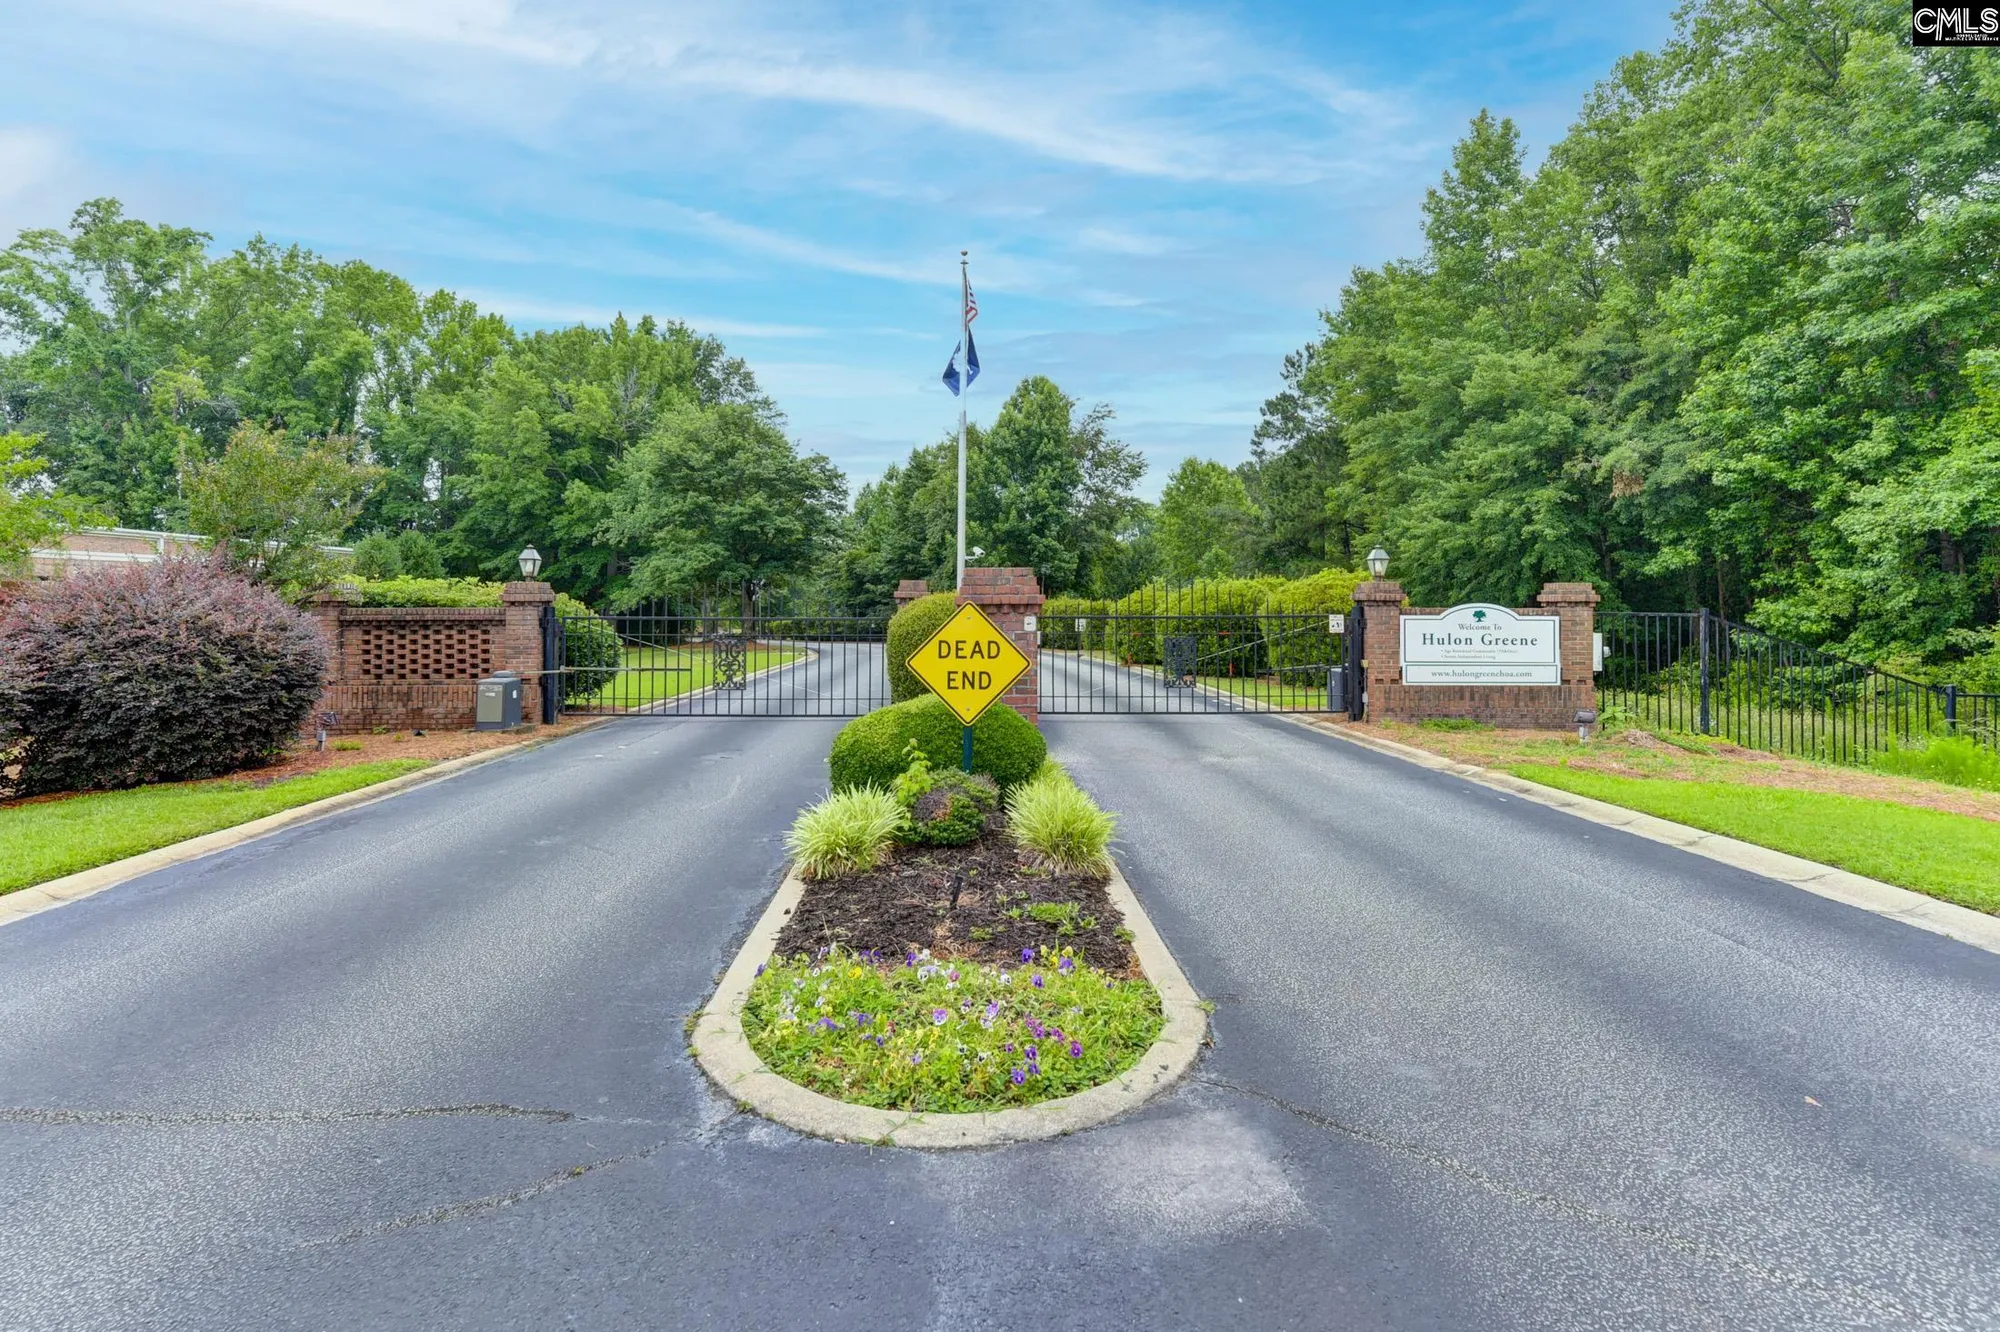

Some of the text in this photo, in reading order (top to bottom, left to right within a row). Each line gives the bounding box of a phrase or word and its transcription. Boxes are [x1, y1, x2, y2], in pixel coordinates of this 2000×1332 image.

[1422, 633, 1539, 646] Hulon Greene
[938, 640, 1001, 659] DEAD
[947, 671, 992, 690] END
[1431, 669, 1532, 681] www.hulongreenehoa.com
